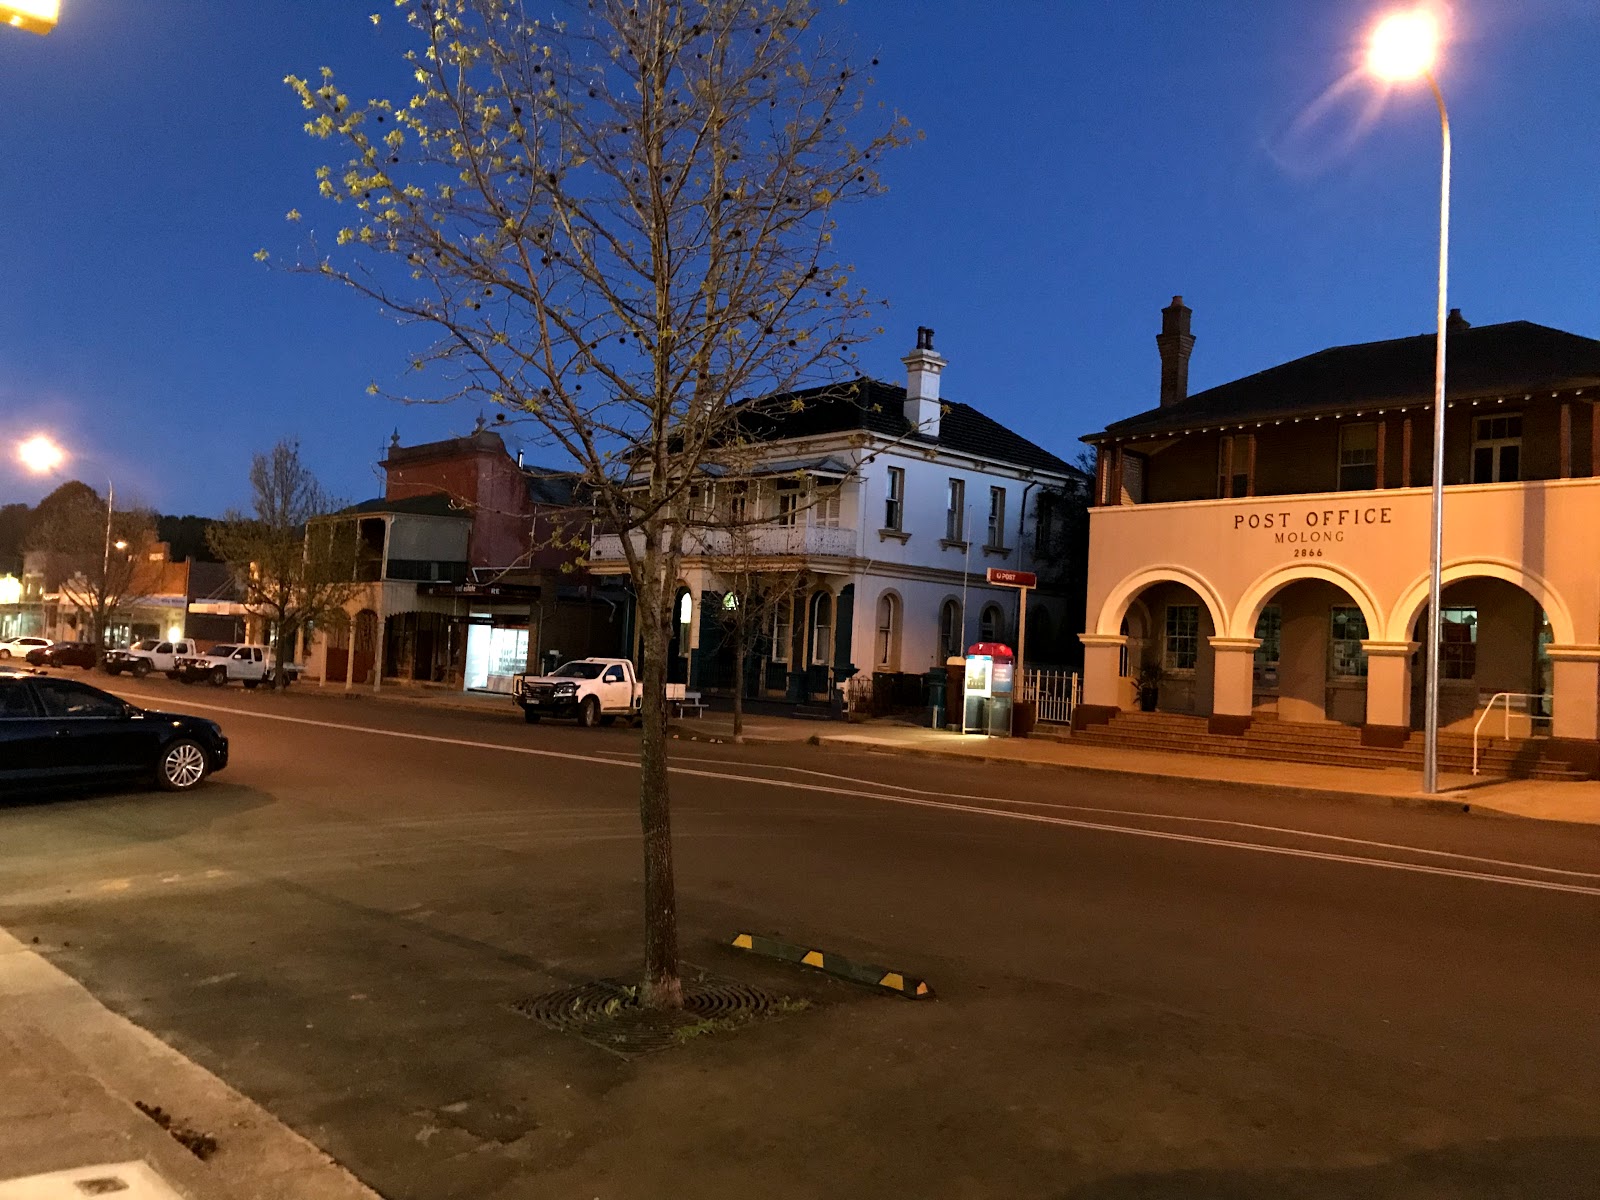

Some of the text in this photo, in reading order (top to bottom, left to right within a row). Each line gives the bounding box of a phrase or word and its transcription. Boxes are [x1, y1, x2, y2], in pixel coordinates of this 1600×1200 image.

[1234, 508, 1392, 529] POST OFFICE
[1275, 531, 1344, 543] MOLONG
[1294, 549, 1323, 557] 2866
